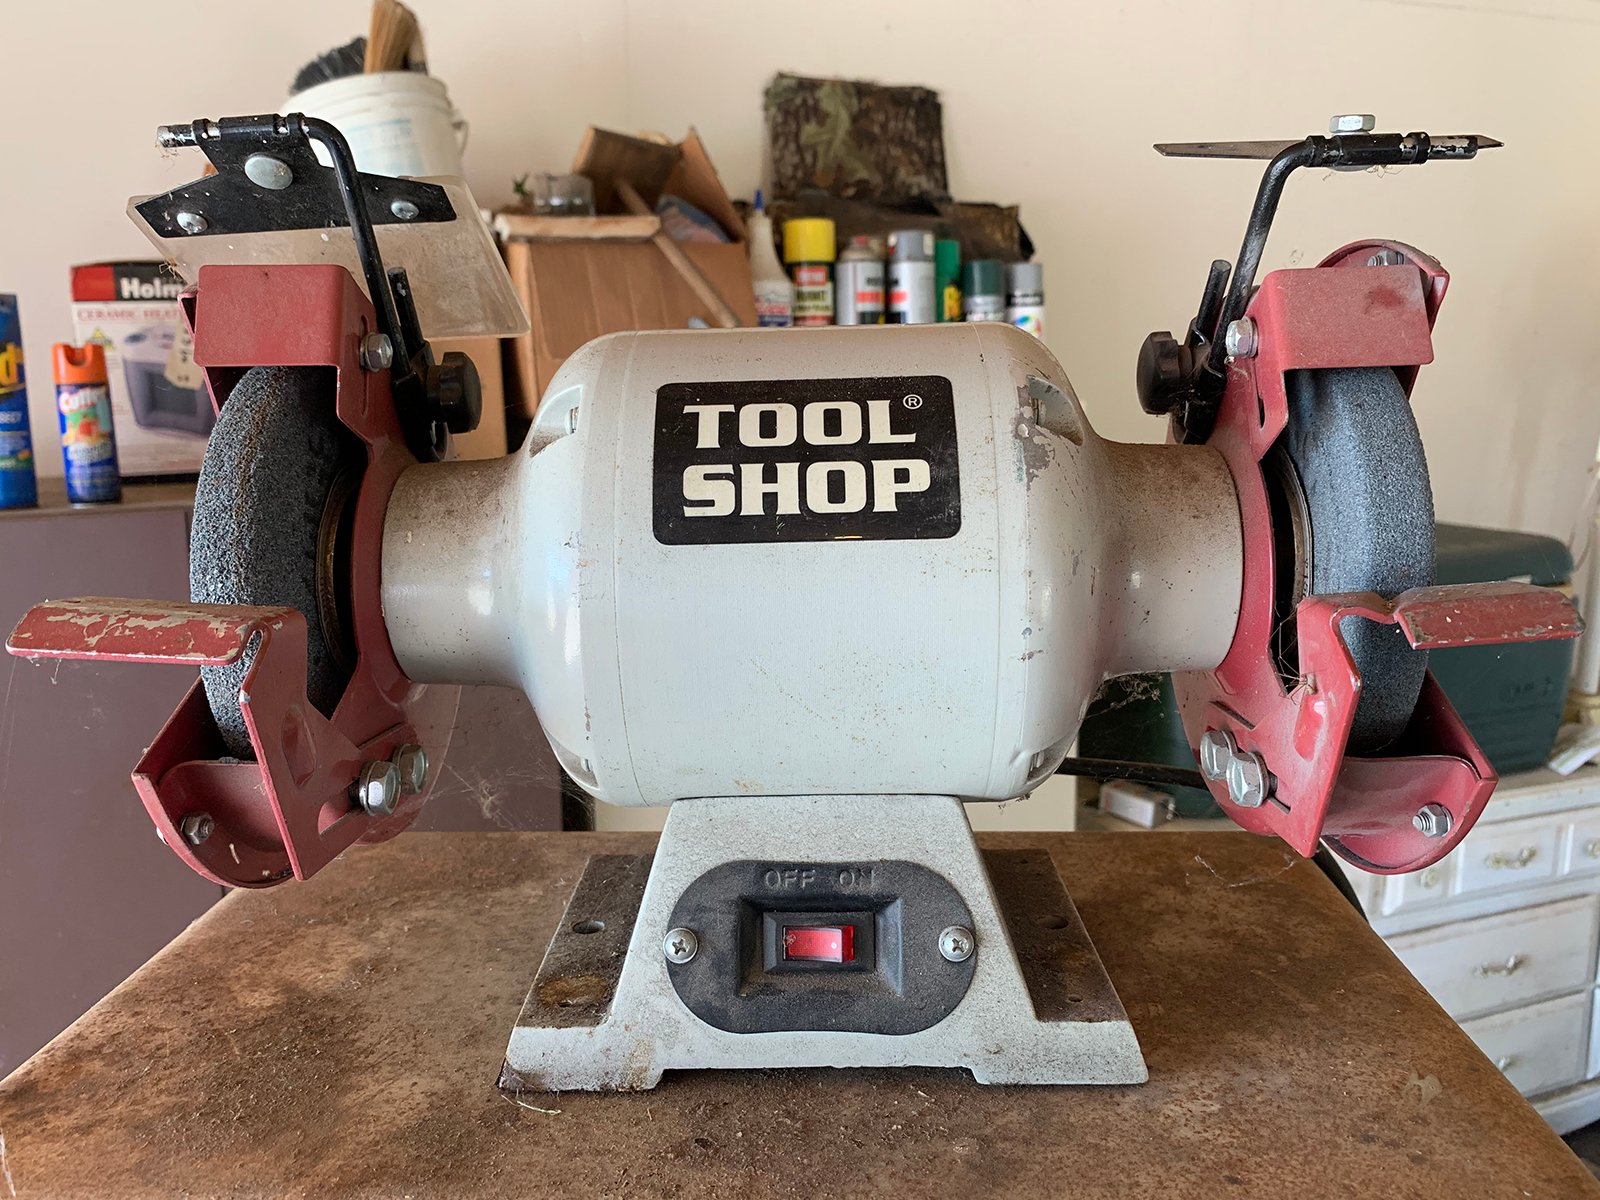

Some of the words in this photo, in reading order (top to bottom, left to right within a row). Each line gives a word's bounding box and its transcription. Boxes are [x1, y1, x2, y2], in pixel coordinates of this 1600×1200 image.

[682, 399, 917, 449] TOOL
[682, 458, 932, 518] SHOP
[765, 868, 816, 890] OFF
[838, 868, 875, 889] ON
